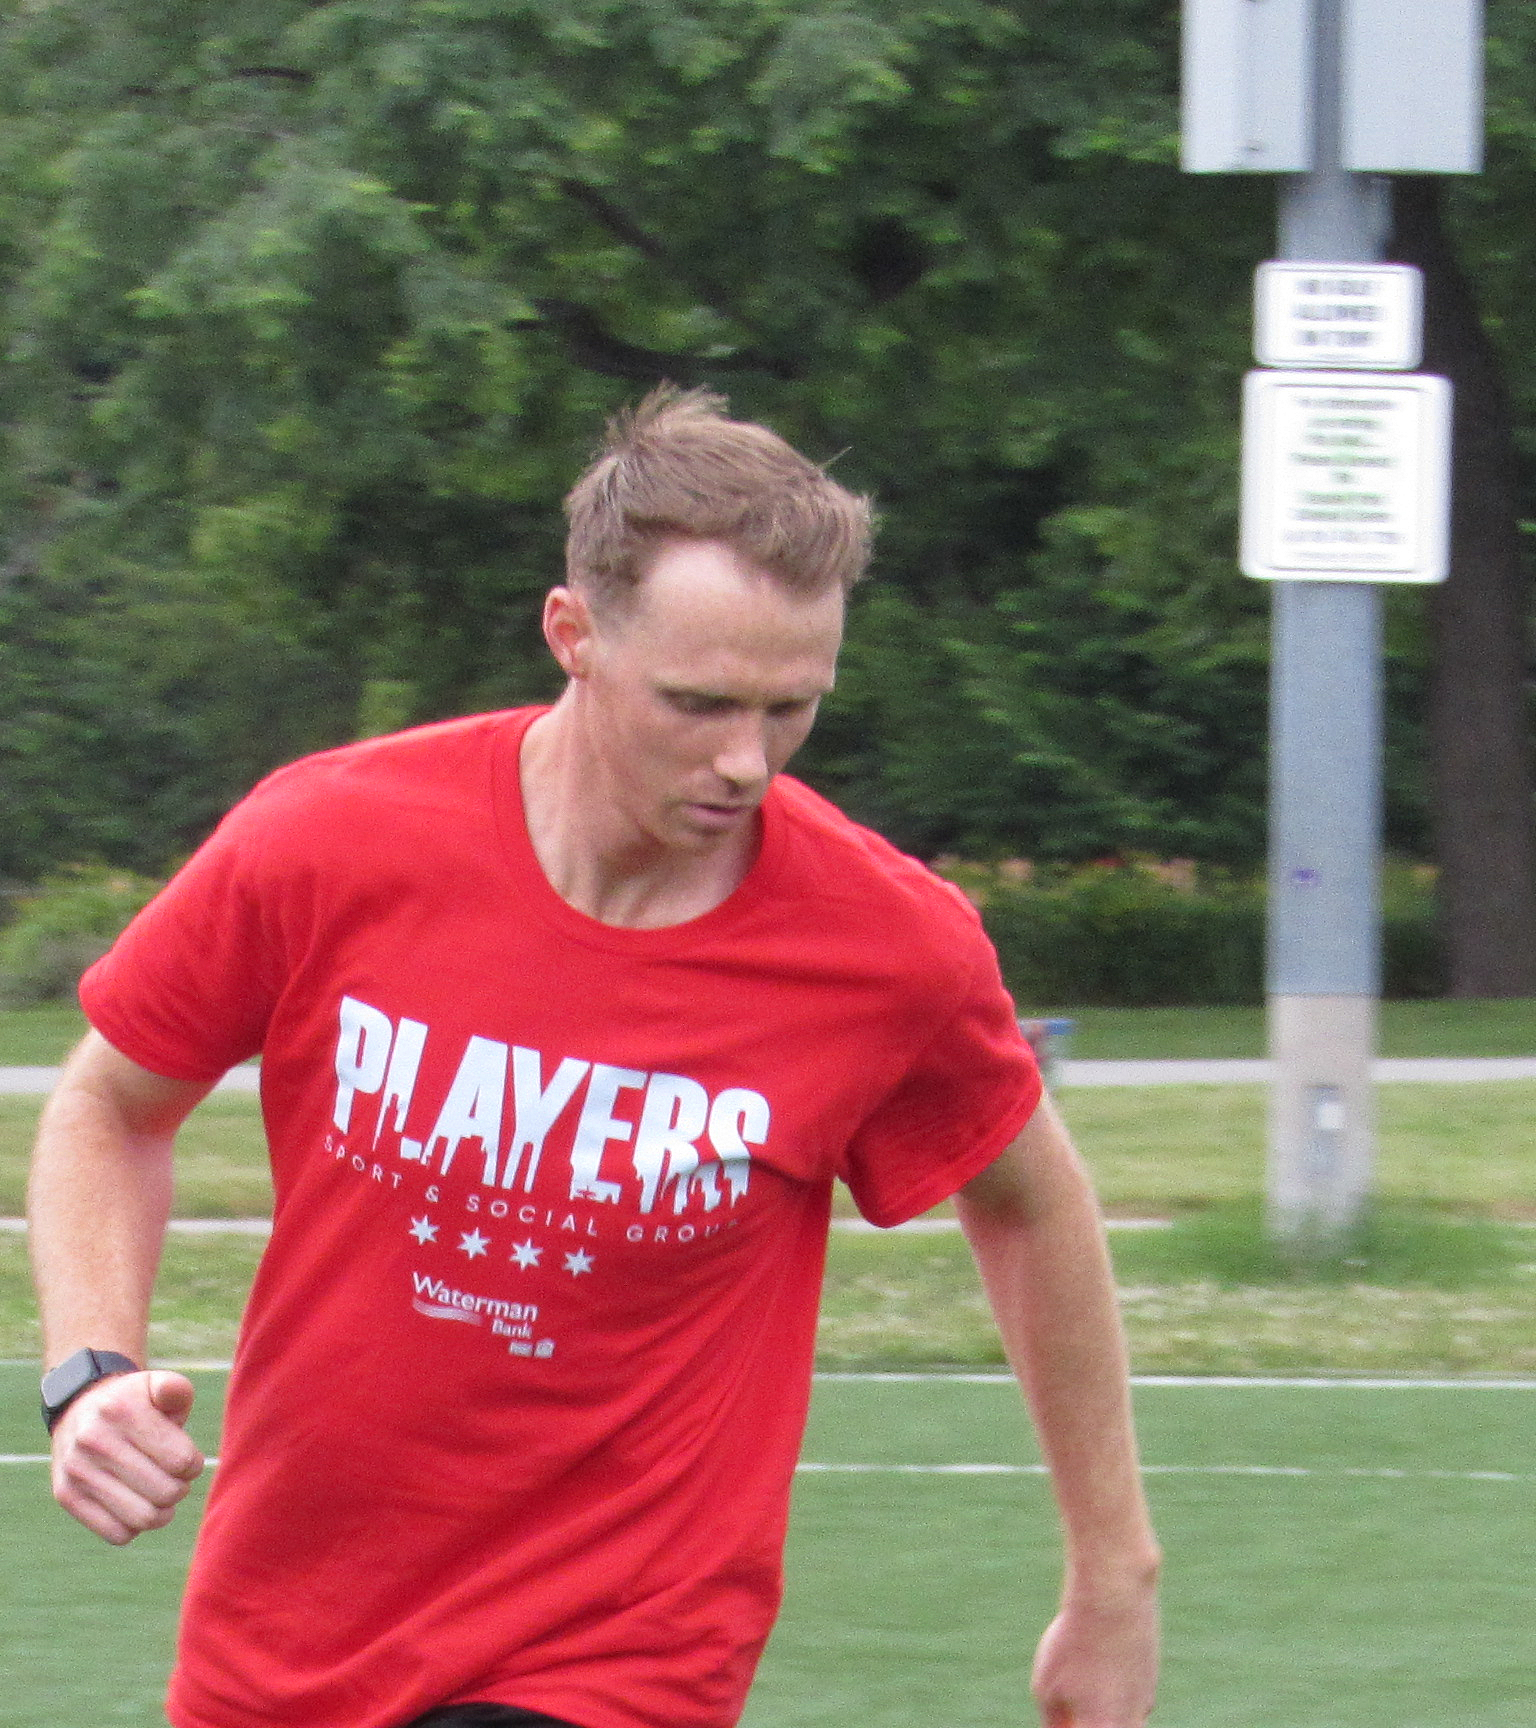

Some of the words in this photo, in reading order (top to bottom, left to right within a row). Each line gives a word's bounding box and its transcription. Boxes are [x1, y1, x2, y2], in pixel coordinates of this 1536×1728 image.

[333, 994, 771, 1216] PLAYERS
[424, 1184, 441, 1203] &
[466, 1193, 598, 1237] SOCIAL
[412, 1271, 540, 1323] Waterman
[491, 1317, 534, 1340] Bank
